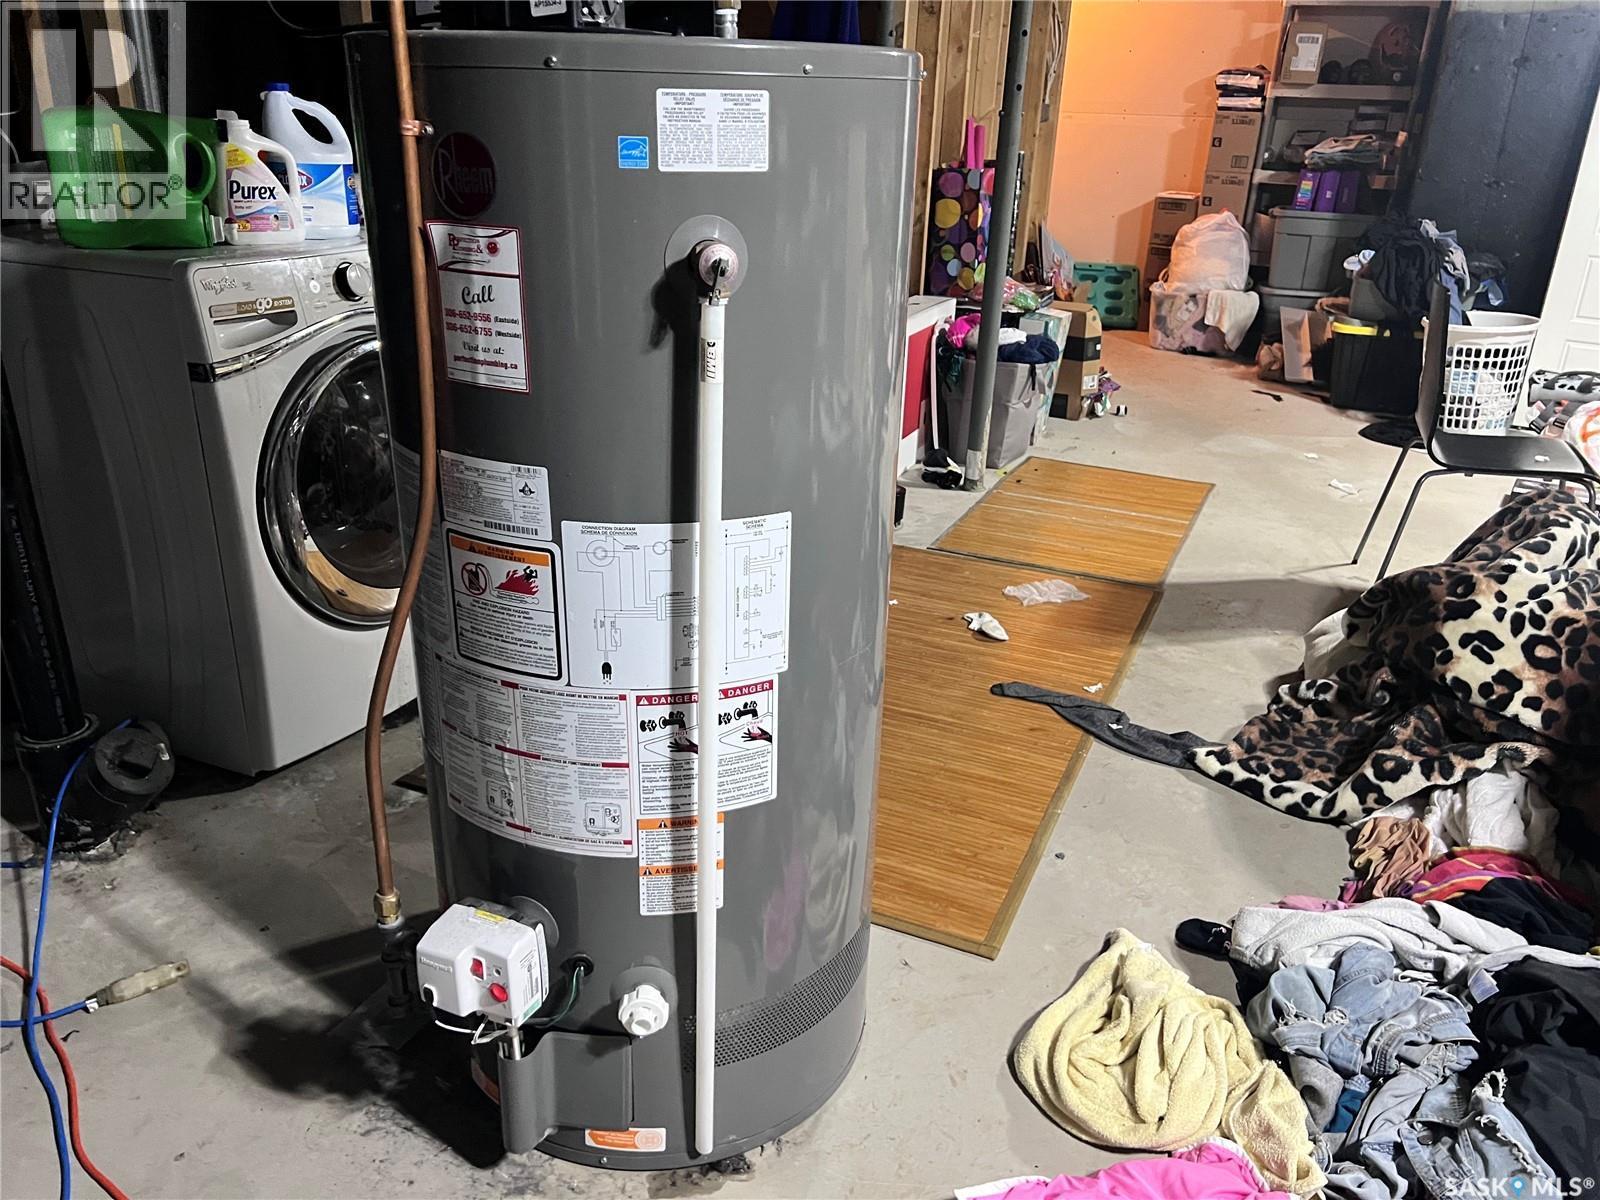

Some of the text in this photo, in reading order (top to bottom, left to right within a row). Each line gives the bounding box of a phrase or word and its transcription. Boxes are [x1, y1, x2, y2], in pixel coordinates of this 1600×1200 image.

[229, 180, 277, 200] Purex
[461, 284, 495, 305] Call
[256, 297, 273, 315] go
[727, 682, 770, 696] DANGER
[652, 694, 698, 703] DANGER
